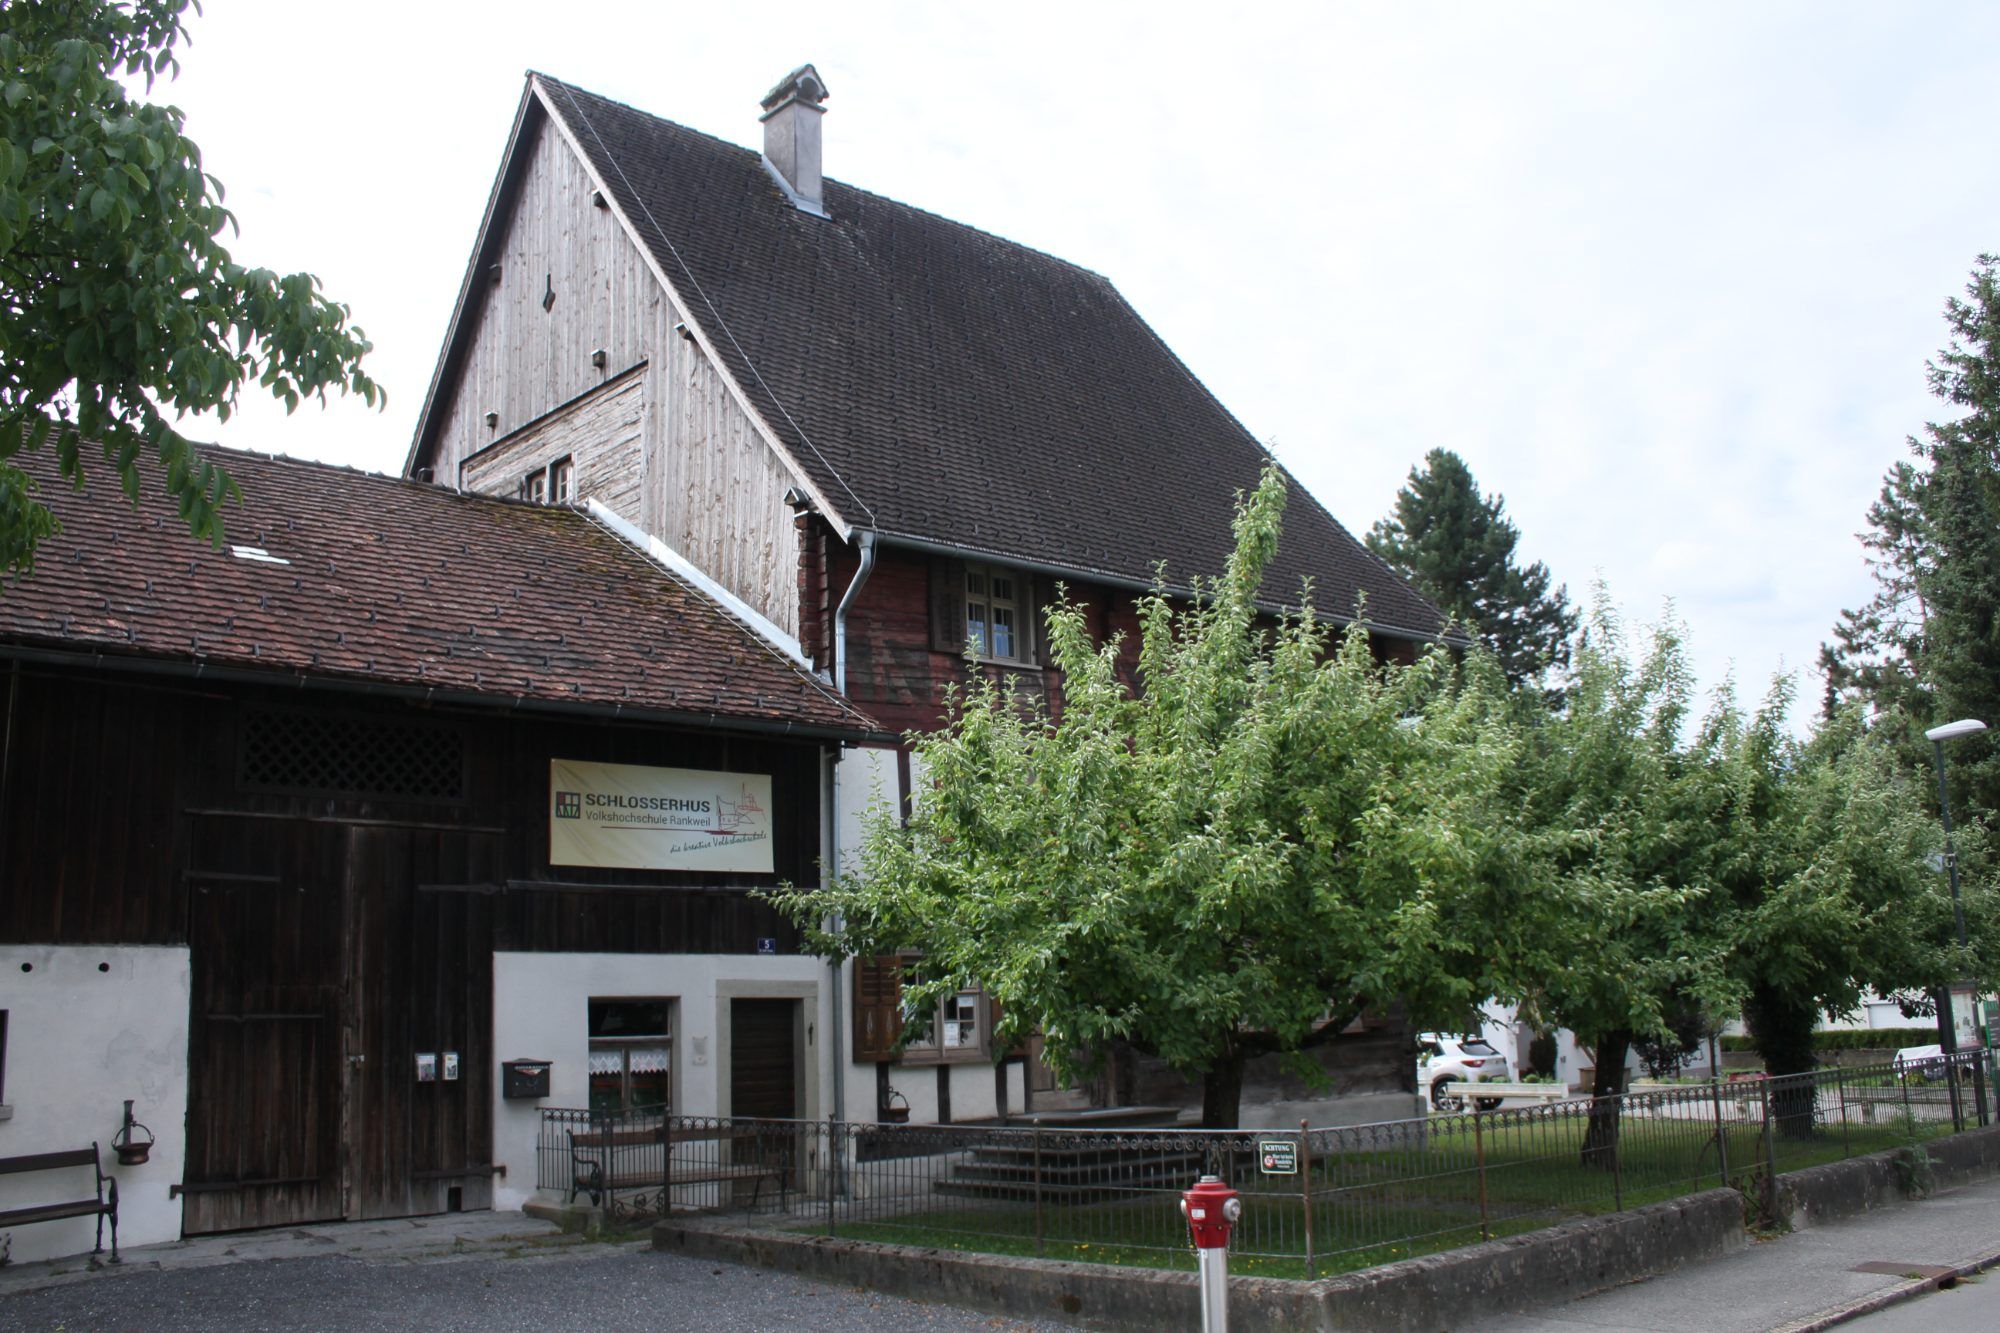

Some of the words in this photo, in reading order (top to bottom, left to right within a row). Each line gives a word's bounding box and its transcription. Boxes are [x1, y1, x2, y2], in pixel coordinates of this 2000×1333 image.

[585, 793, 710, 813] SCHLOSSERHUS
[585, 810, 667, 825] Volkshochschule
[669, 815, 711, 827] Rankweil
[670, 843, 681, 853] die
[764, 939, 770, 949] 5
